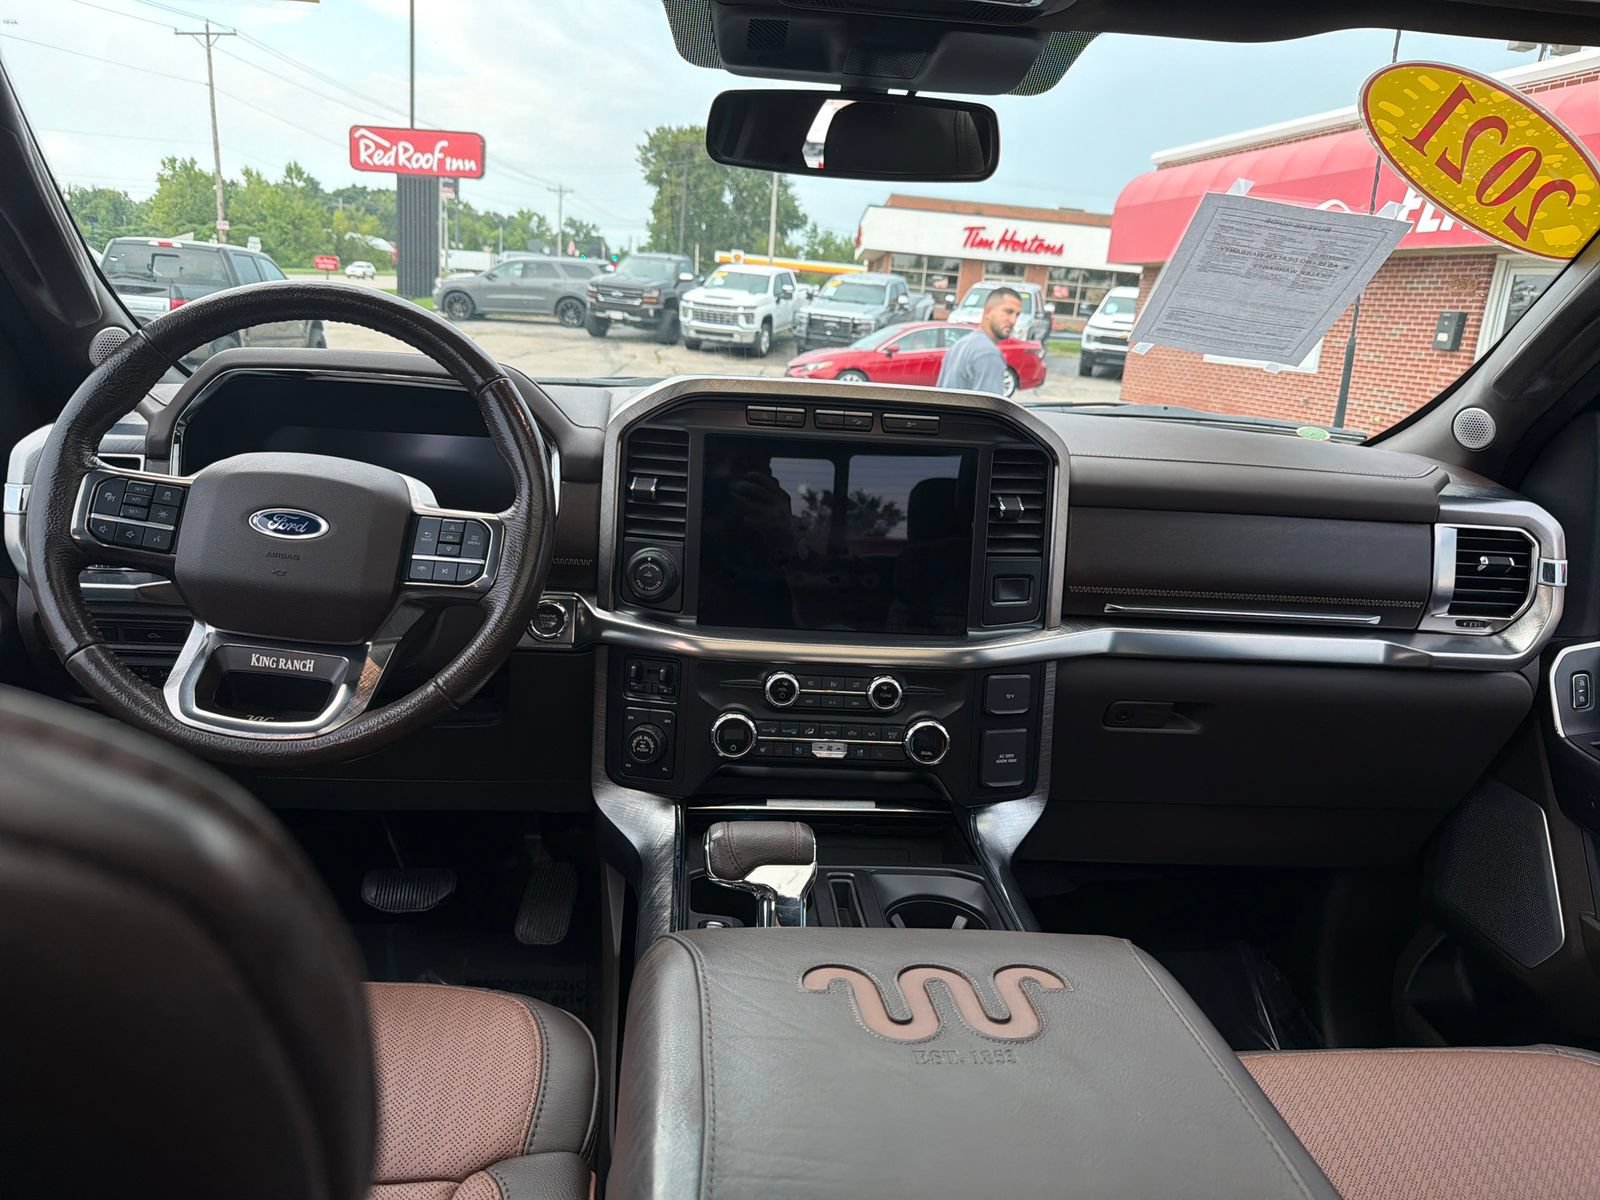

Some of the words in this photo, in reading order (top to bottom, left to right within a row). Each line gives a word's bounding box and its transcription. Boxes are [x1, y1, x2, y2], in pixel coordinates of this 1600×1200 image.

[962, 225, 993, 251] Tim
[995, 227, 1064, 257] Hortons
[267, 513, 310, 533] Ford
[265, 551, 301, 561] AIRBAG
[250, 653, 277, 669] KING
[278, 657, 315, 673] RANCH
